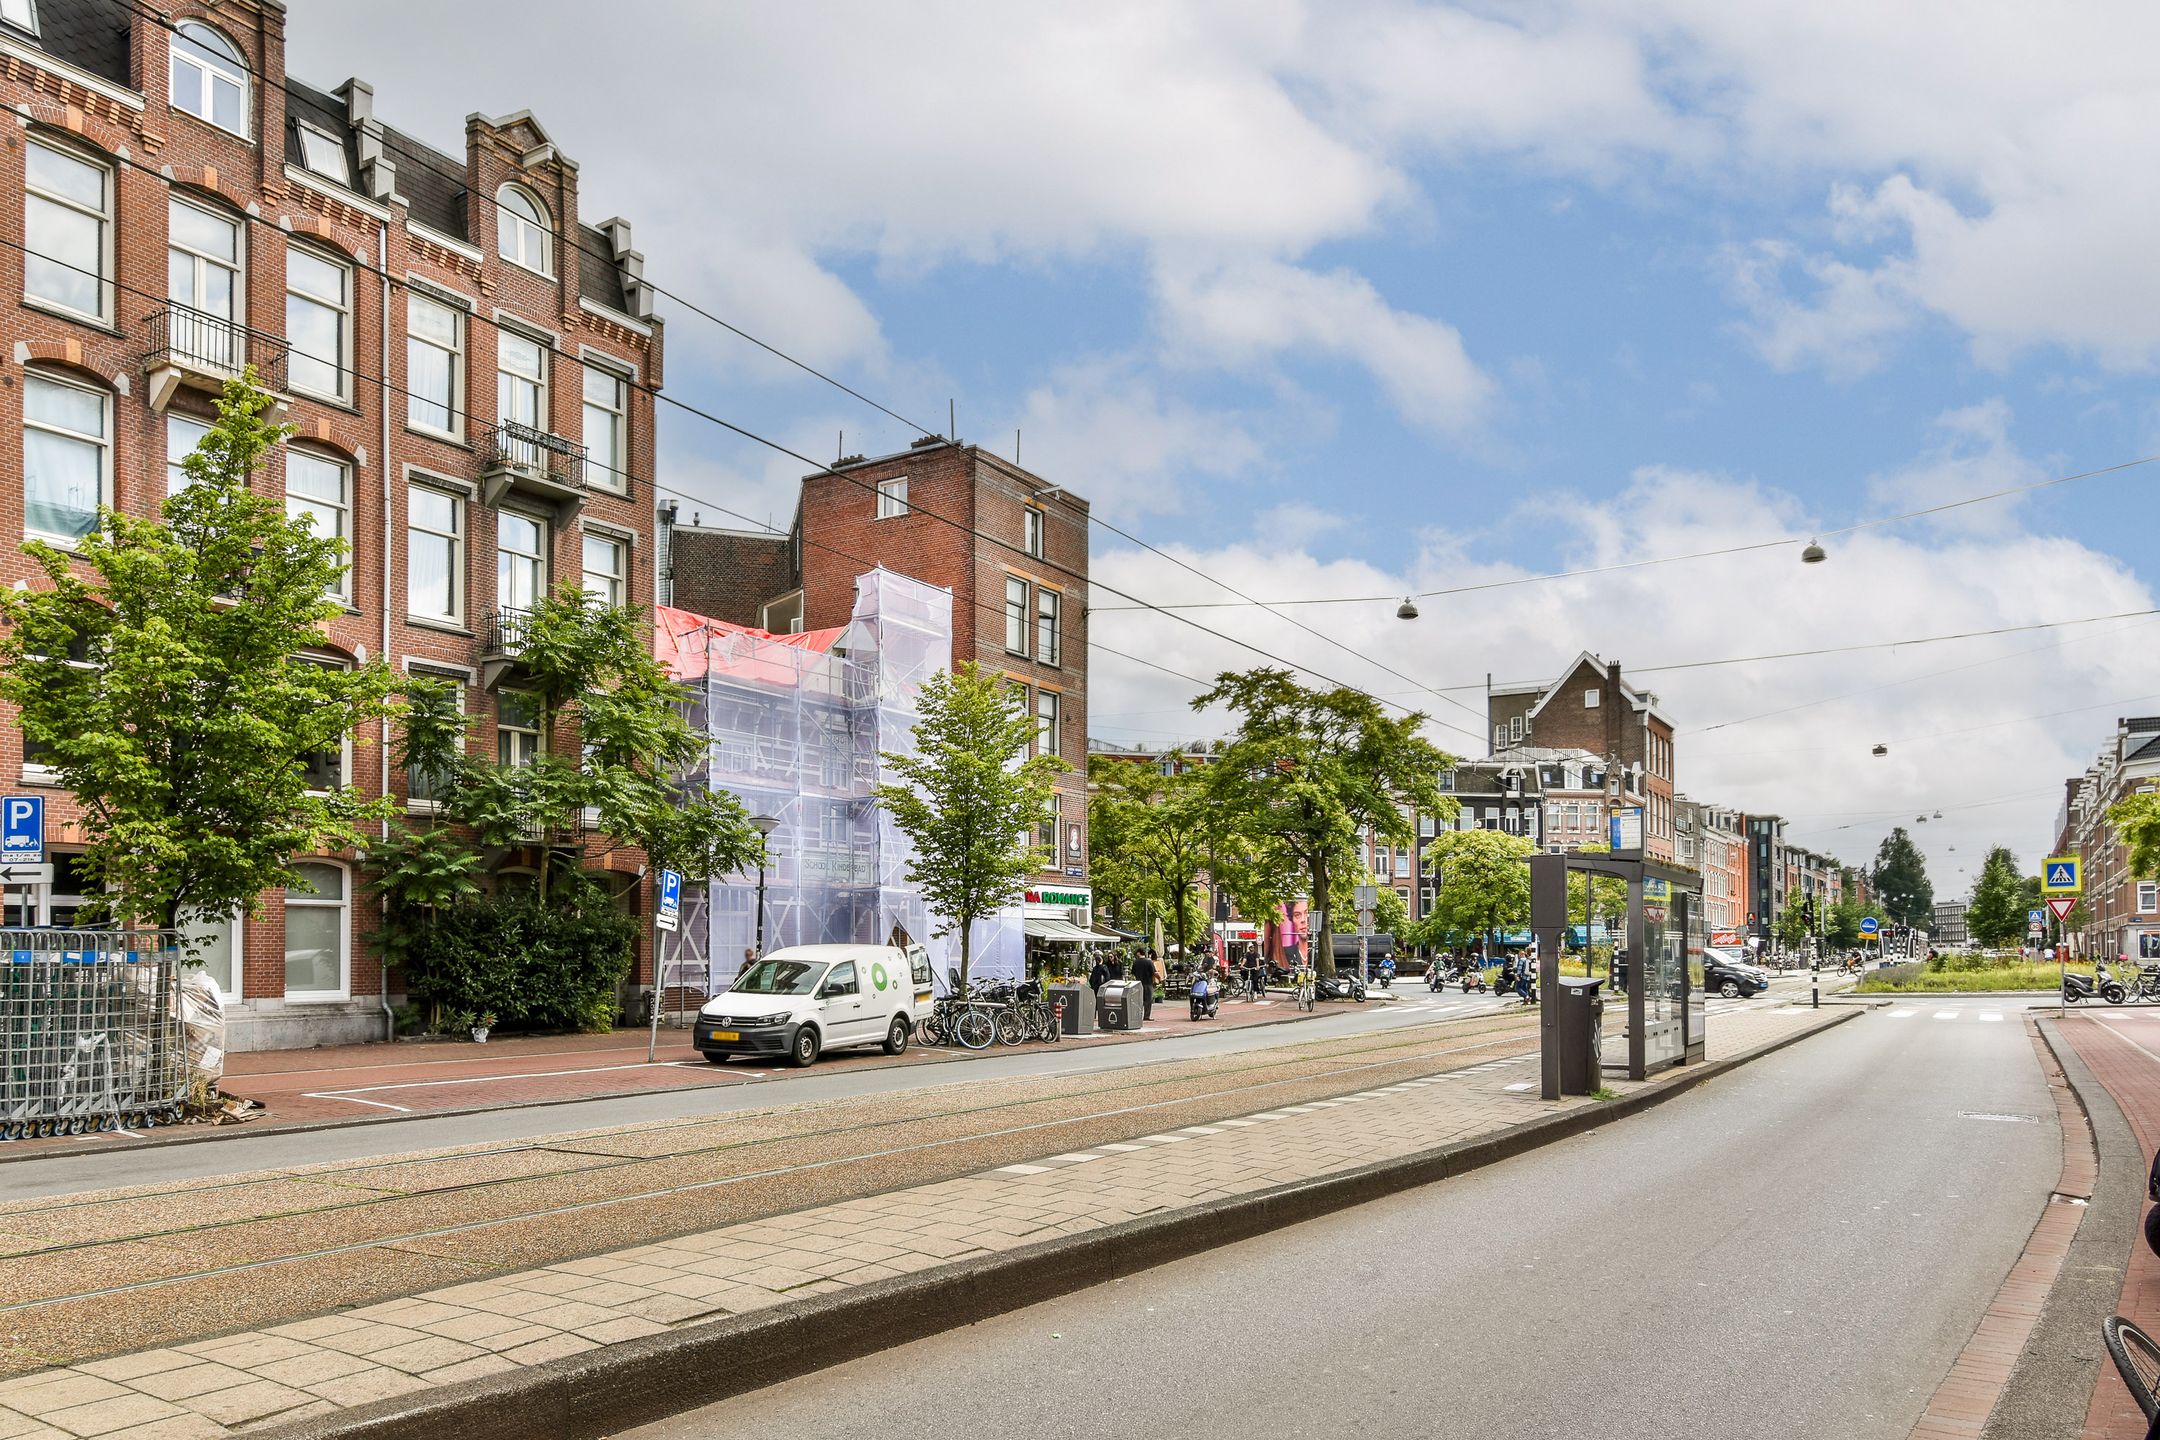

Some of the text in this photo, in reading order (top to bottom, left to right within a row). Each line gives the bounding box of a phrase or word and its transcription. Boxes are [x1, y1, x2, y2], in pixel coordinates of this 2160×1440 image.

[11, 801, 33, 829] P
[666, 873, 677, 893] P
[1041, 891, 1089, 906] ROMANCE
